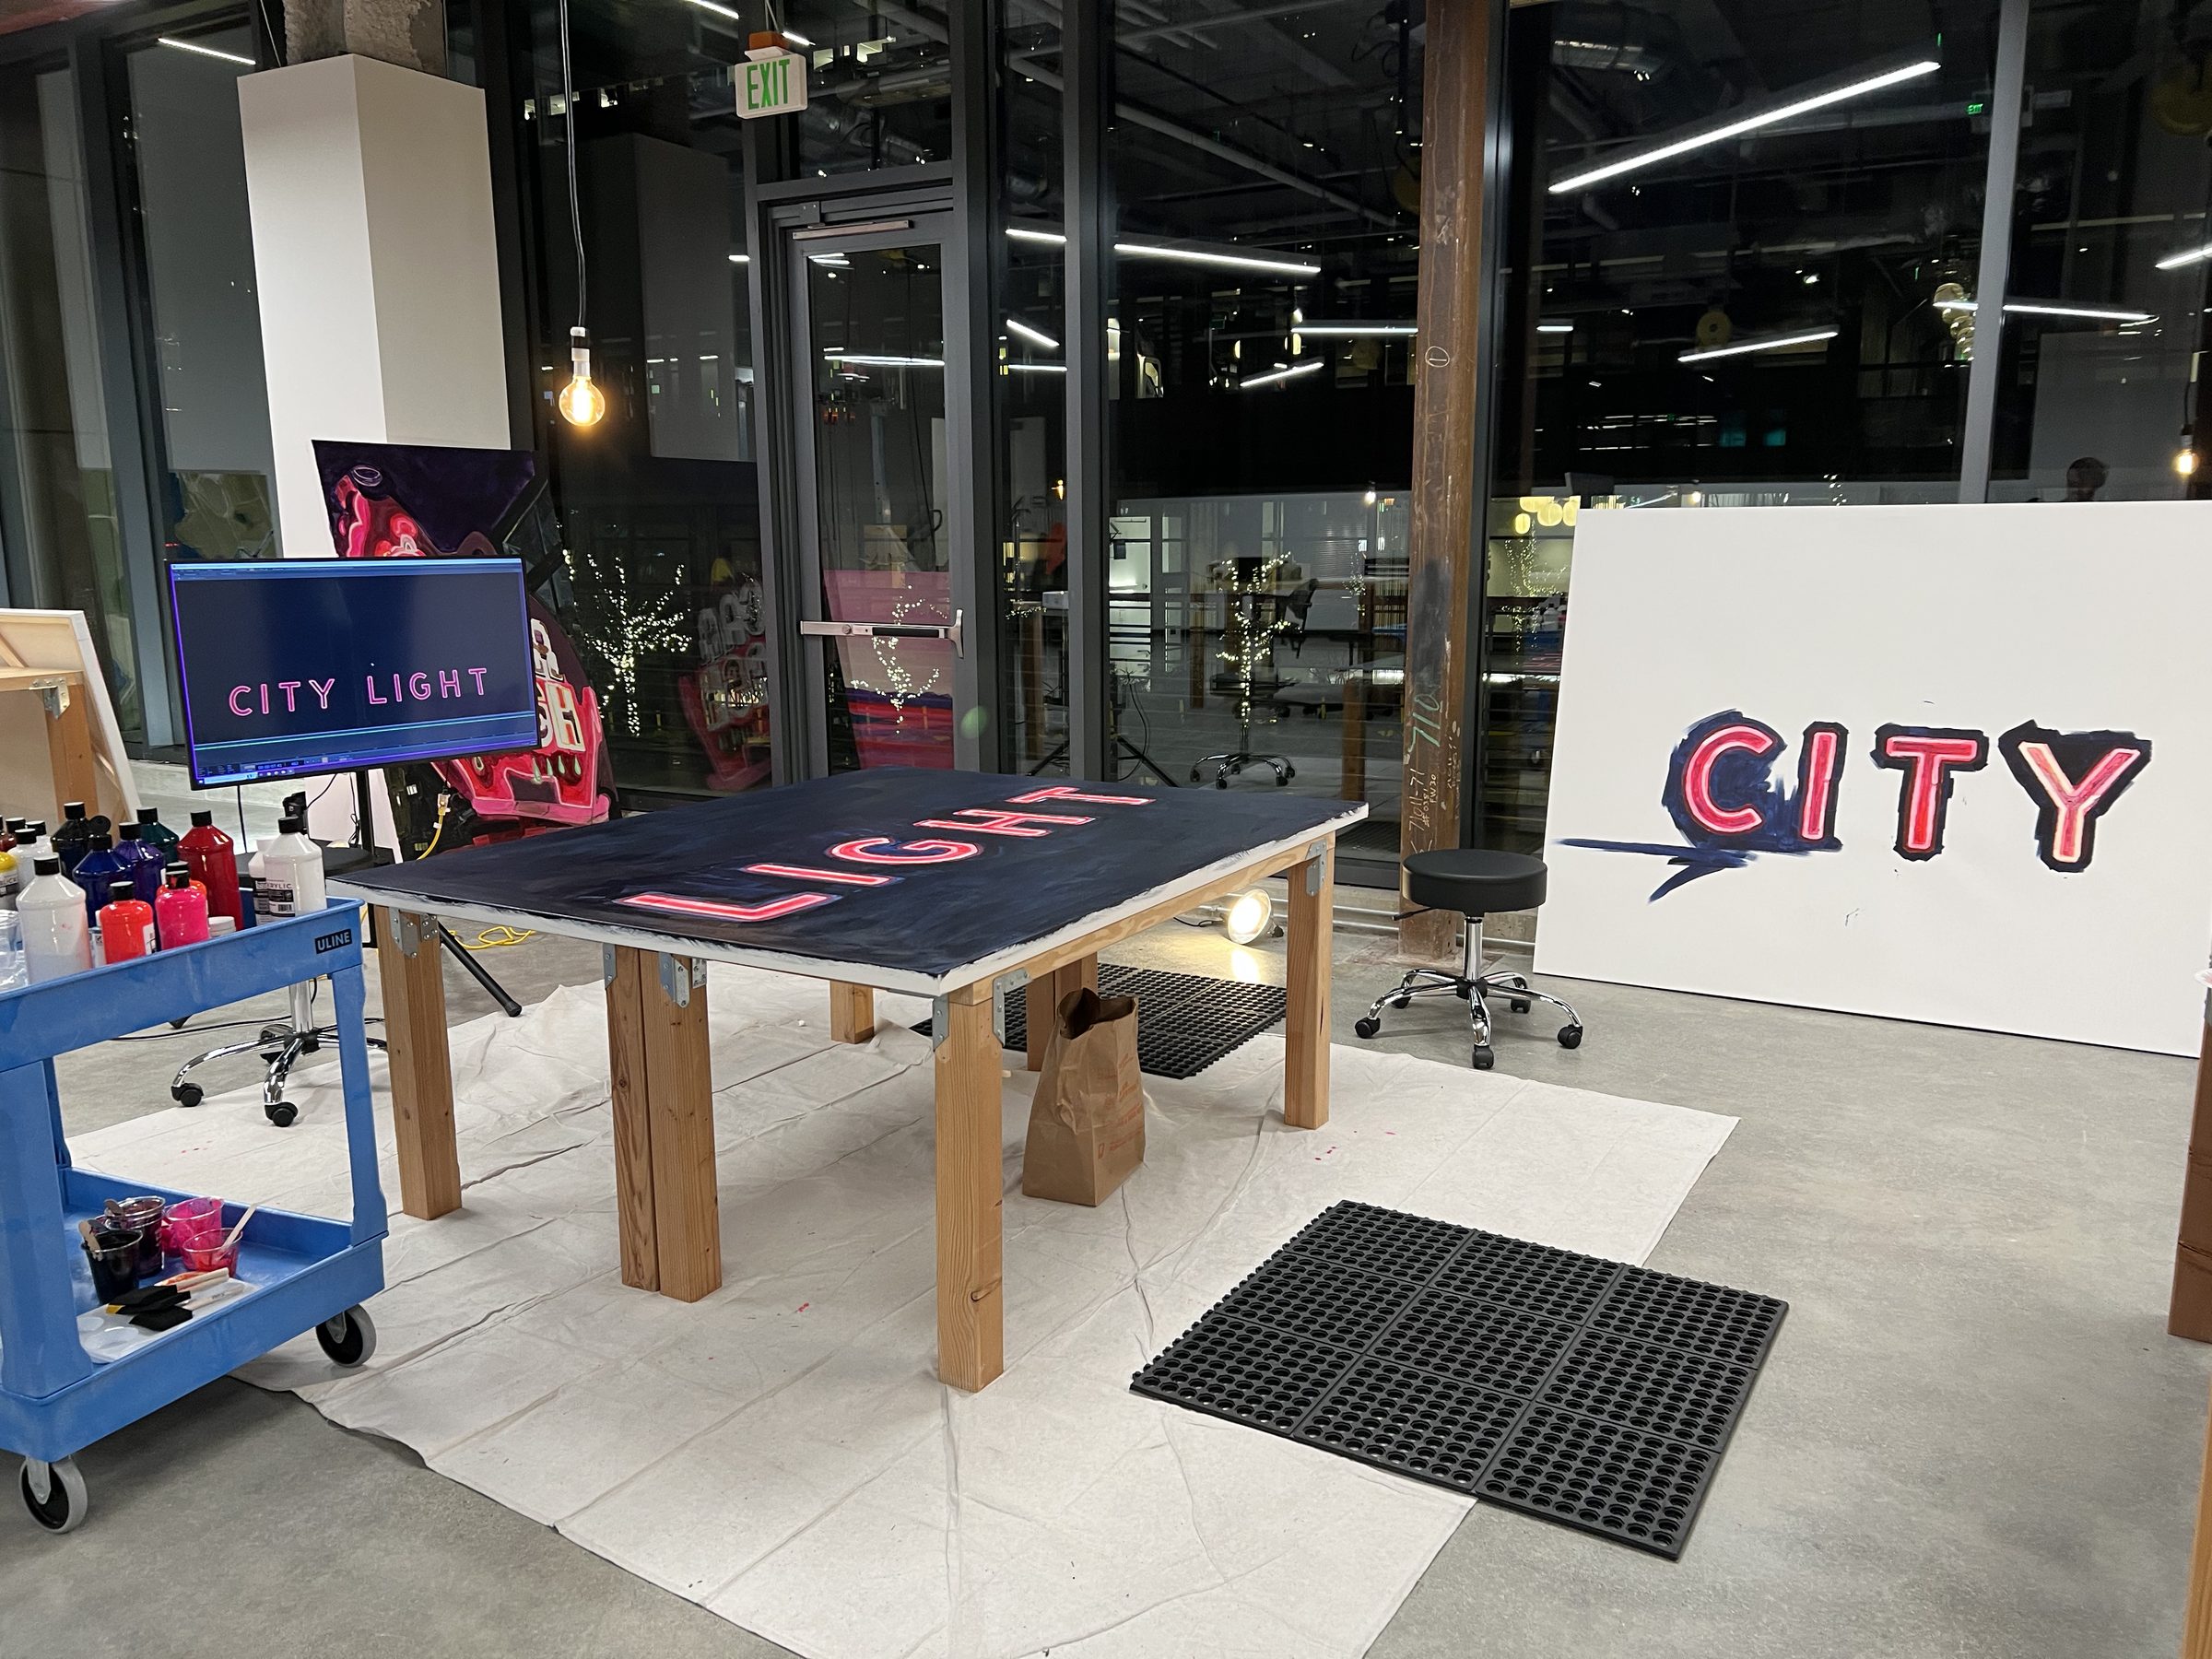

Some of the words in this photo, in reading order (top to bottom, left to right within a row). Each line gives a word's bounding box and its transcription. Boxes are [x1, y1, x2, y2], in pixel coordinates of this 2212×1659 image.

[747, 58, 790, 110] EXIT
[229, 678, 335, 716] CITY
[368, 667, 487, 704] LIGHT
[1681, 724, 2141, 864] CITY
[617, 786, 1157, 922] LIGHT
[317, 932, 351, 951] ULINE
